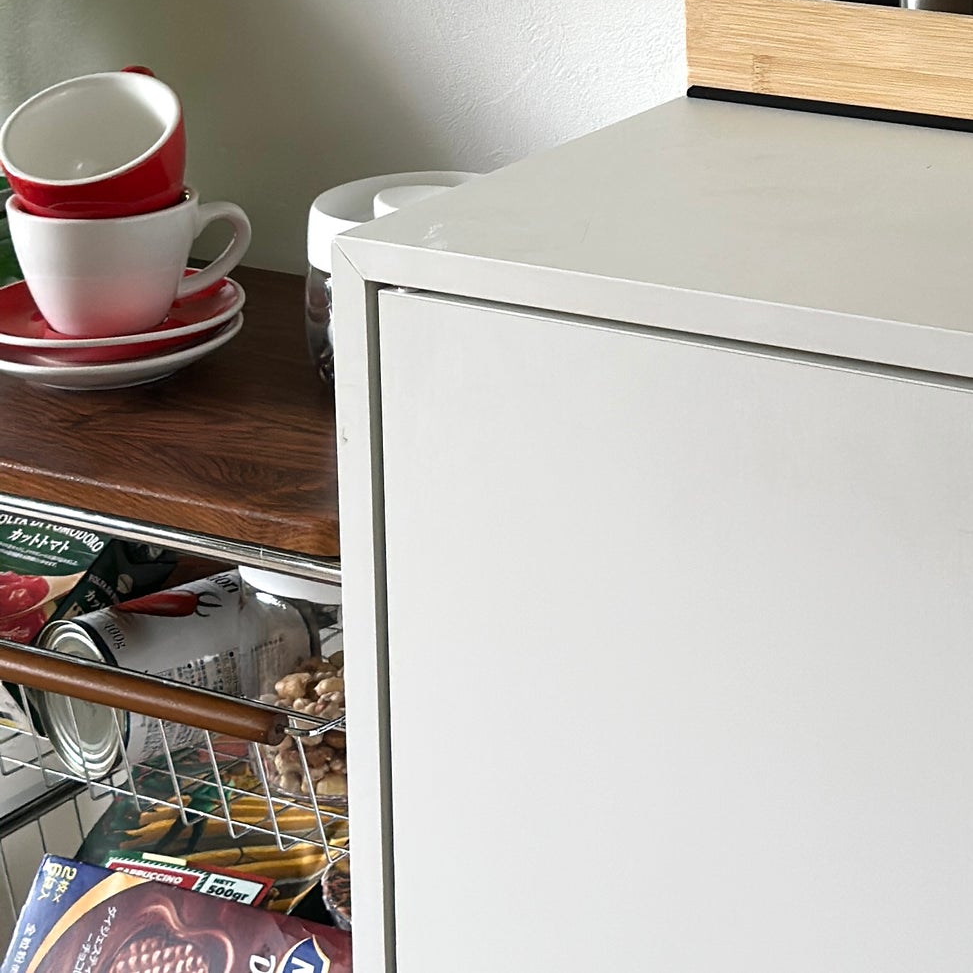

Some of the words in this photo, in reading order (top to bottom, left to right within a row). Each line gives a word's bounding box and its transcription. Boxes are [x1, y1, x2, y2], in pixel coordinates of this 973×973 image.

[7, 528, 70, 554] カットトマト
[213, 877, 236, 887] NETT
[206, 884, 250, 902] 500gr
